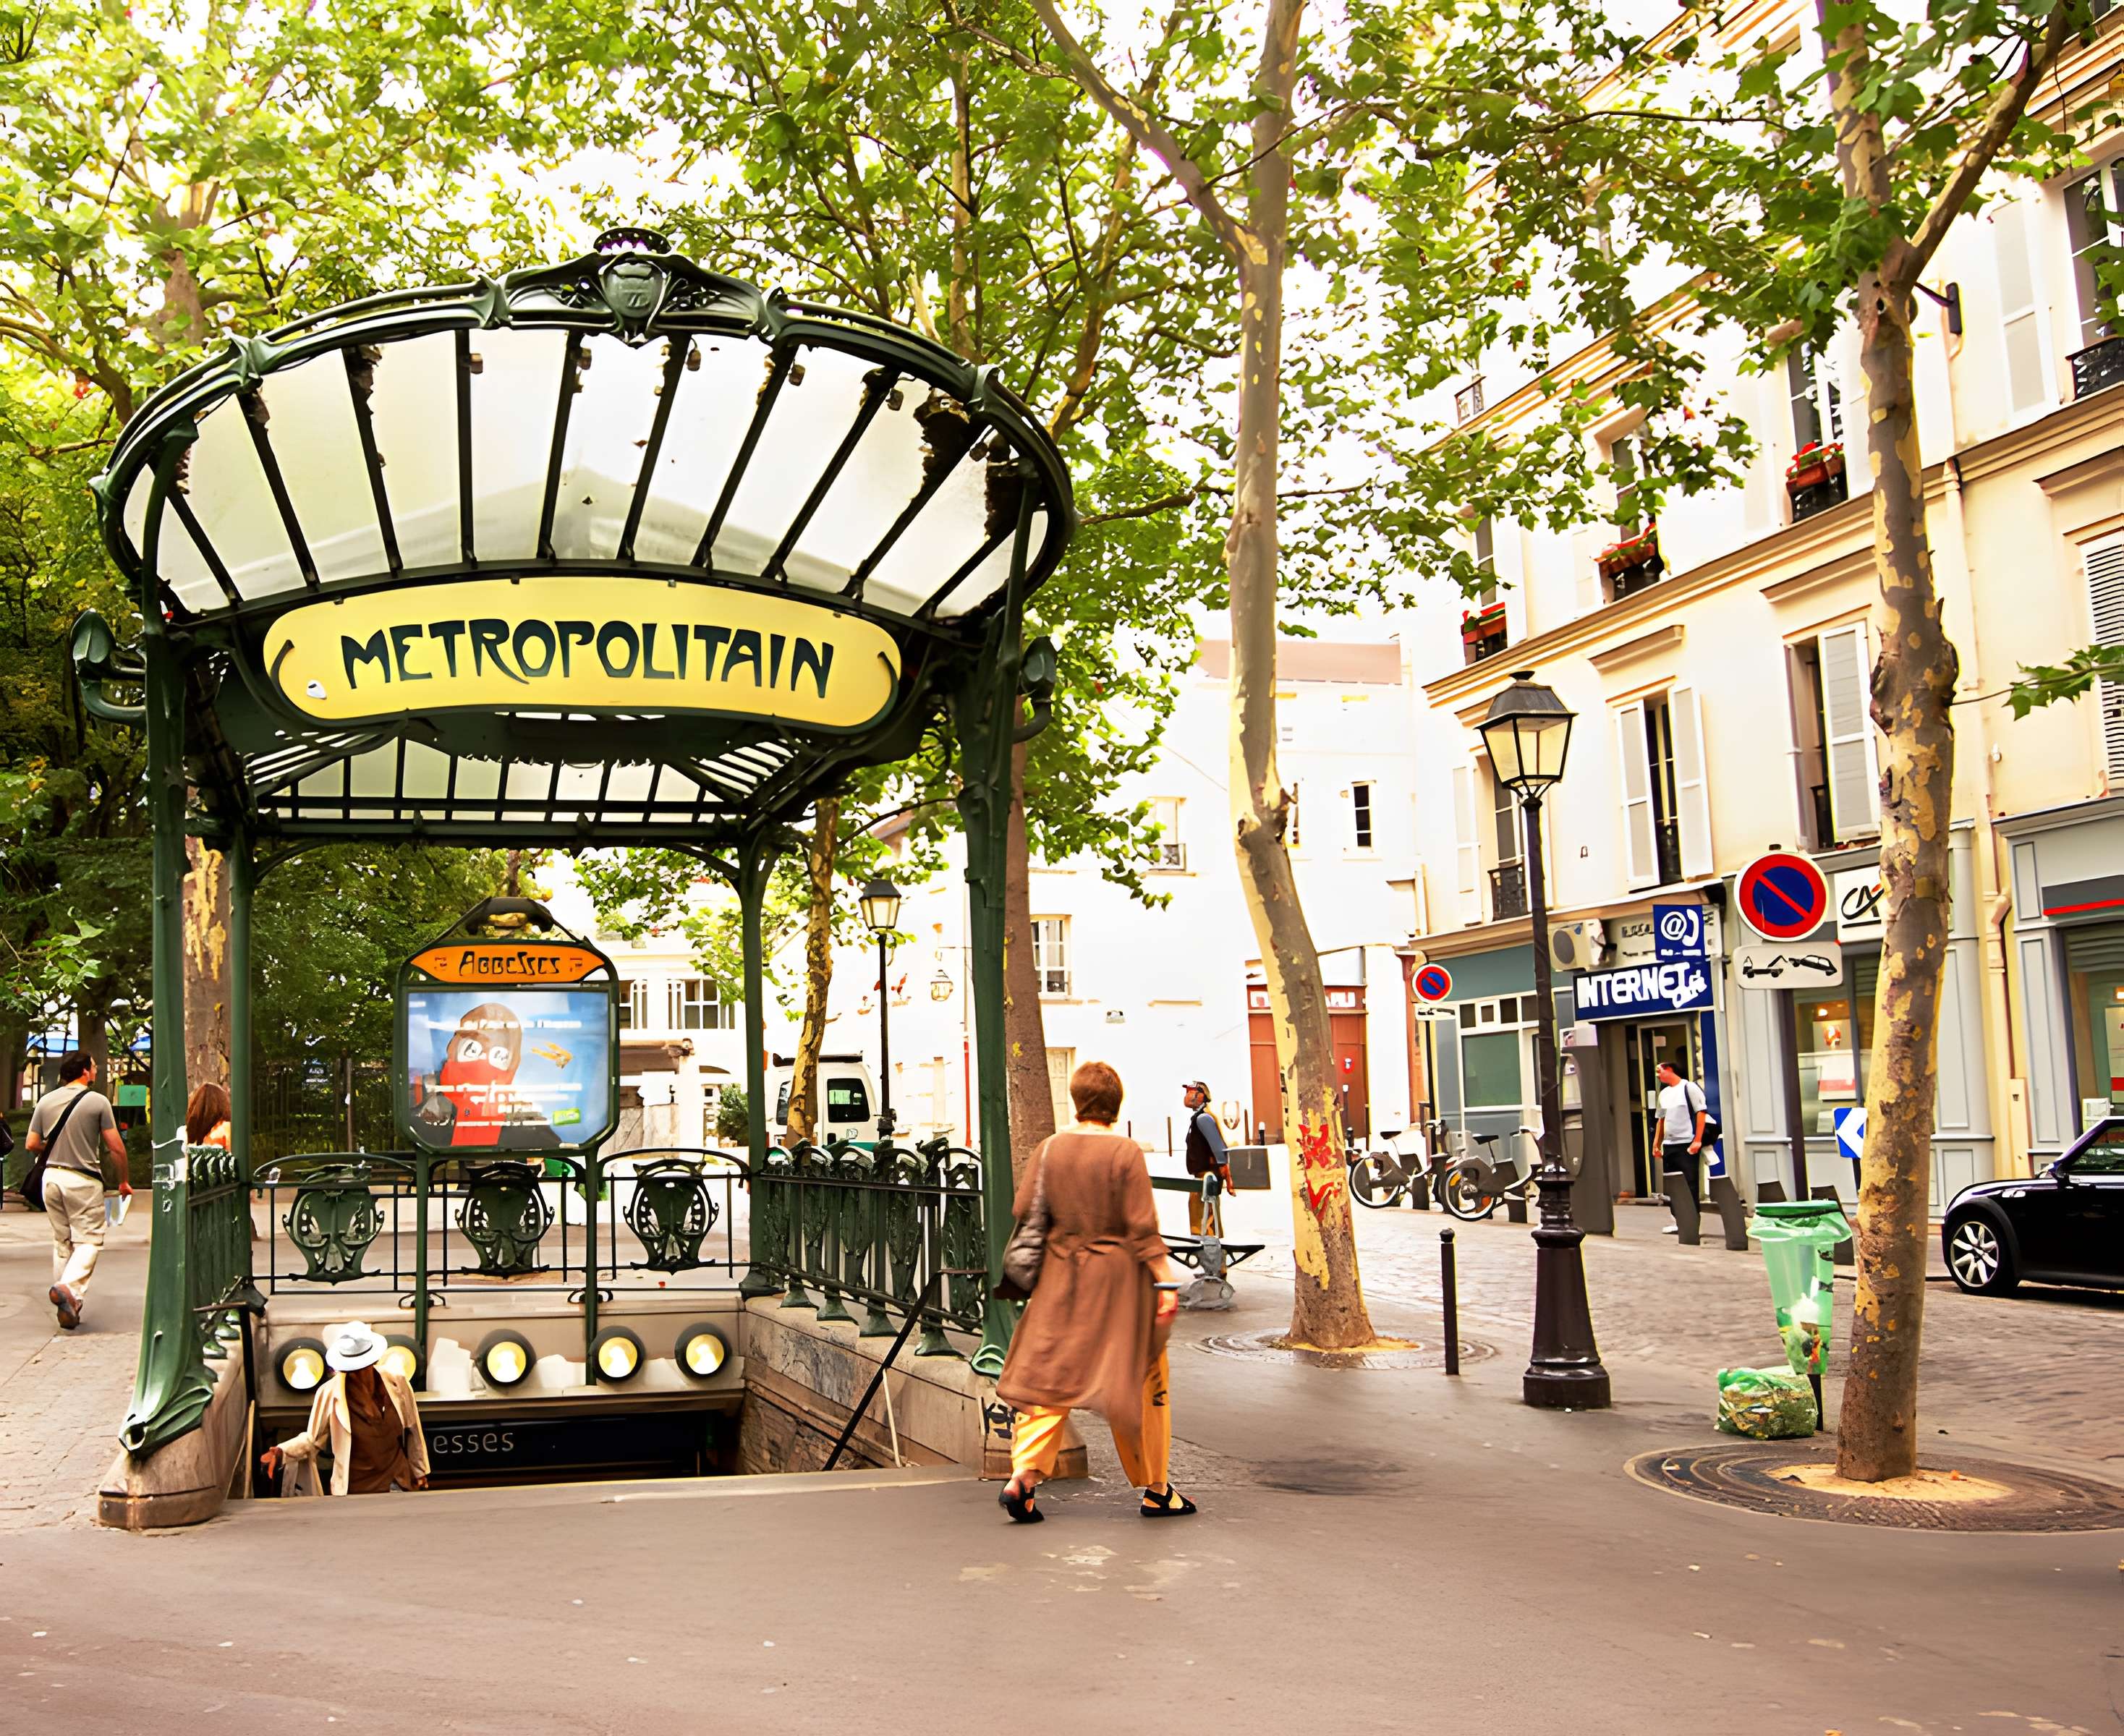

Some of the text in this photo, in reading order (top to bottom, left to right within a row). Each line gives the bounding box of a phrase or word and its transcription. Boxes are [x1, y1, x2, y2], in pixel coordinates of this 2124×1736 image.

[341, 618, 834, 699] METROPOLITAIN
[1576, 961, 1690, 1009] INTERNET
[433, 1432, 514, 1454] esses
